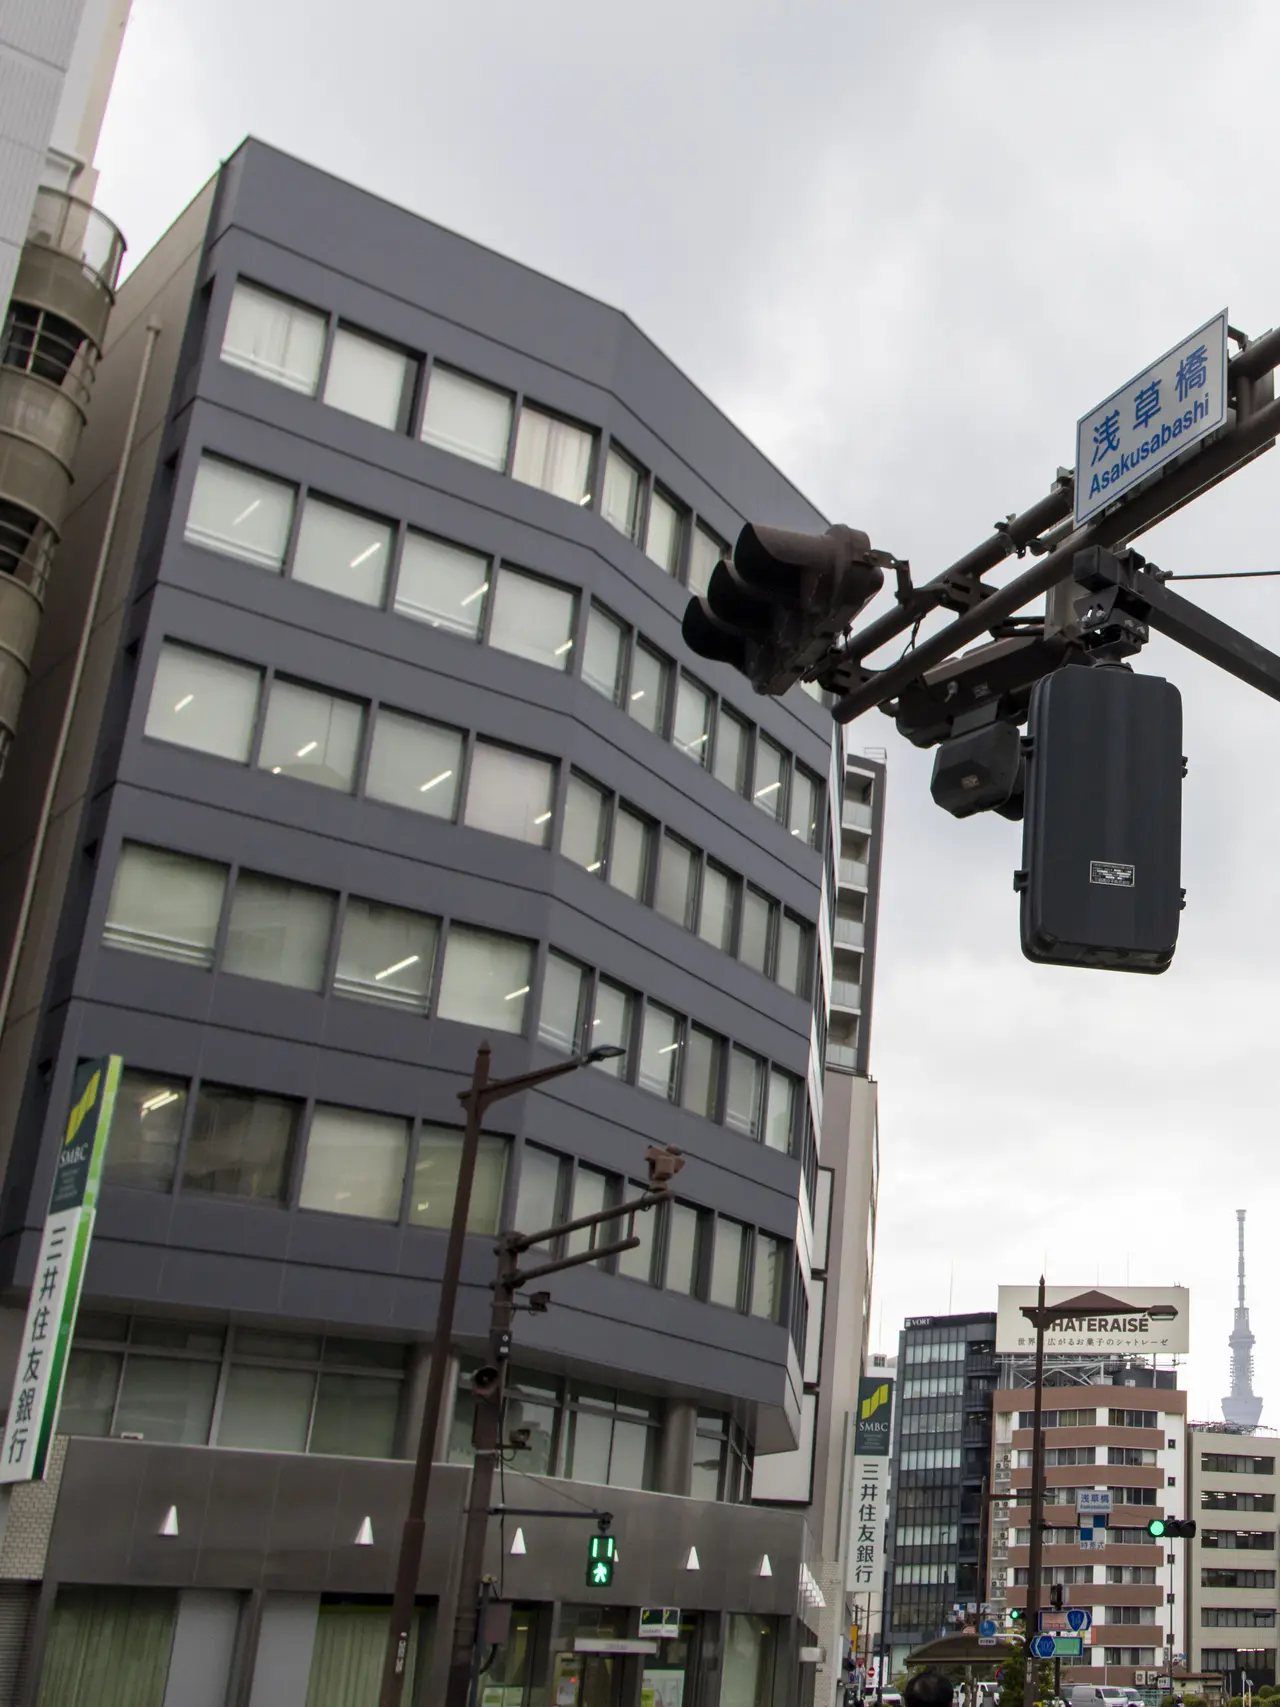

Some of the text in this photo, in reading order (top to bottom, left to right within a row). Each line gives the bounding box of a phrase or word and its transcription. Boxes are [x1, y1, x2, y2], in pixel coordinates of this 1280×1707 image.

[1090, 344, 1208, 467] 浅草橋
[1089, 393, 1209, 500] Asakusabashi
[58, 1142, 89, 1168] SMBC
[911, 1318, 931, 1326] VORT
[8, 1226, 67, 1464] 三井住友銀行
[1018, 1337, 1169, 1346] 世界広がるお菓子のシャトレーゼ
[859, 1421, 888, 1432] SMBC
[1080, 1493, 1110, 1504] 浅草橋
[855, 1464, 880, 1583] 三井住友銀行
